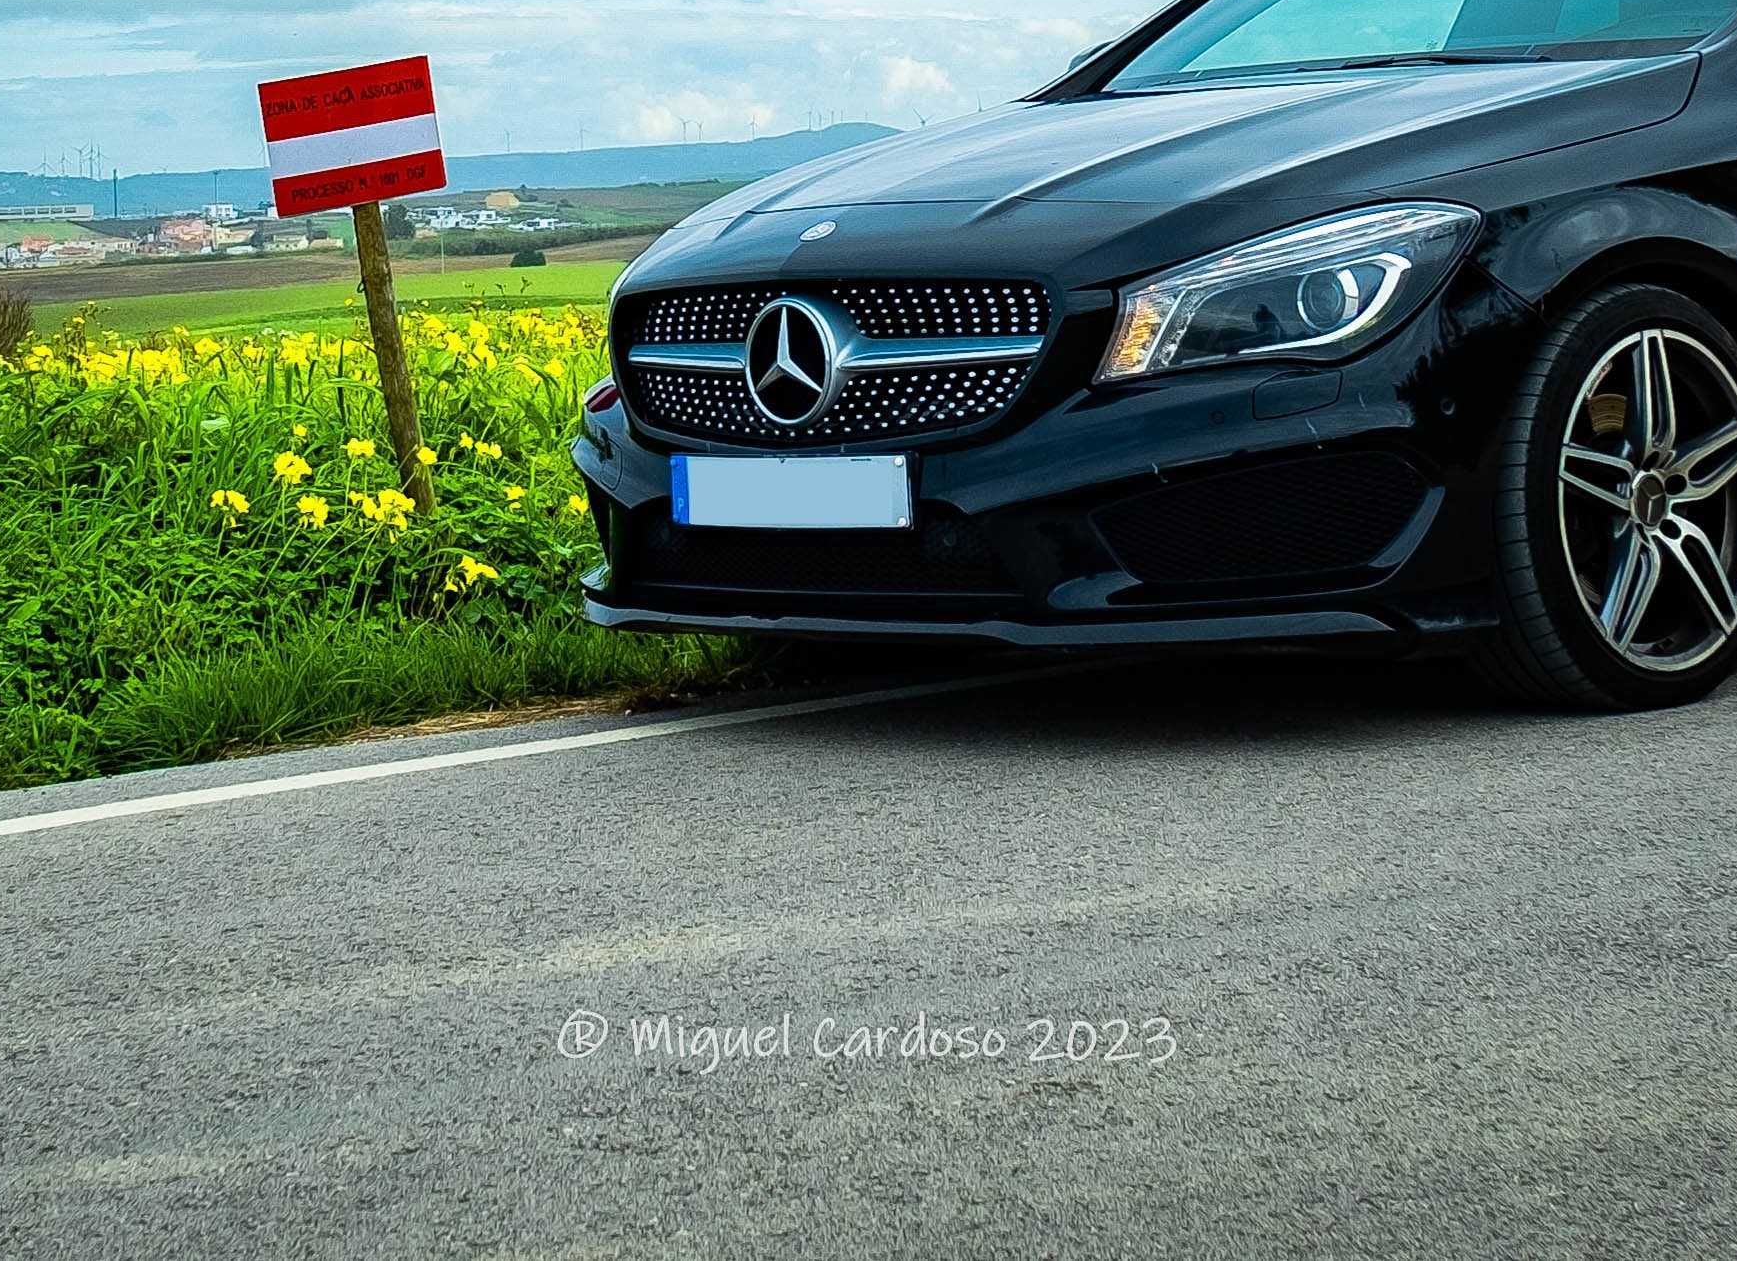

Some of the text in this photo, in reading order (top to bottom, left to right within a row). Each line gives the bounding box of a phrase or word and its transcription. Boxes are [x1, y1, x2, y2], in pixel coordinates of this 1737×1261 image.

[266, 99, 297, 116] ZONA
[302, 94, 318, 111] DE
[360, 77, 425, 99] ASSOCIATIVA
[291, 178, 354, 203] PROCESSO
[677, 496, 685, 514] P
